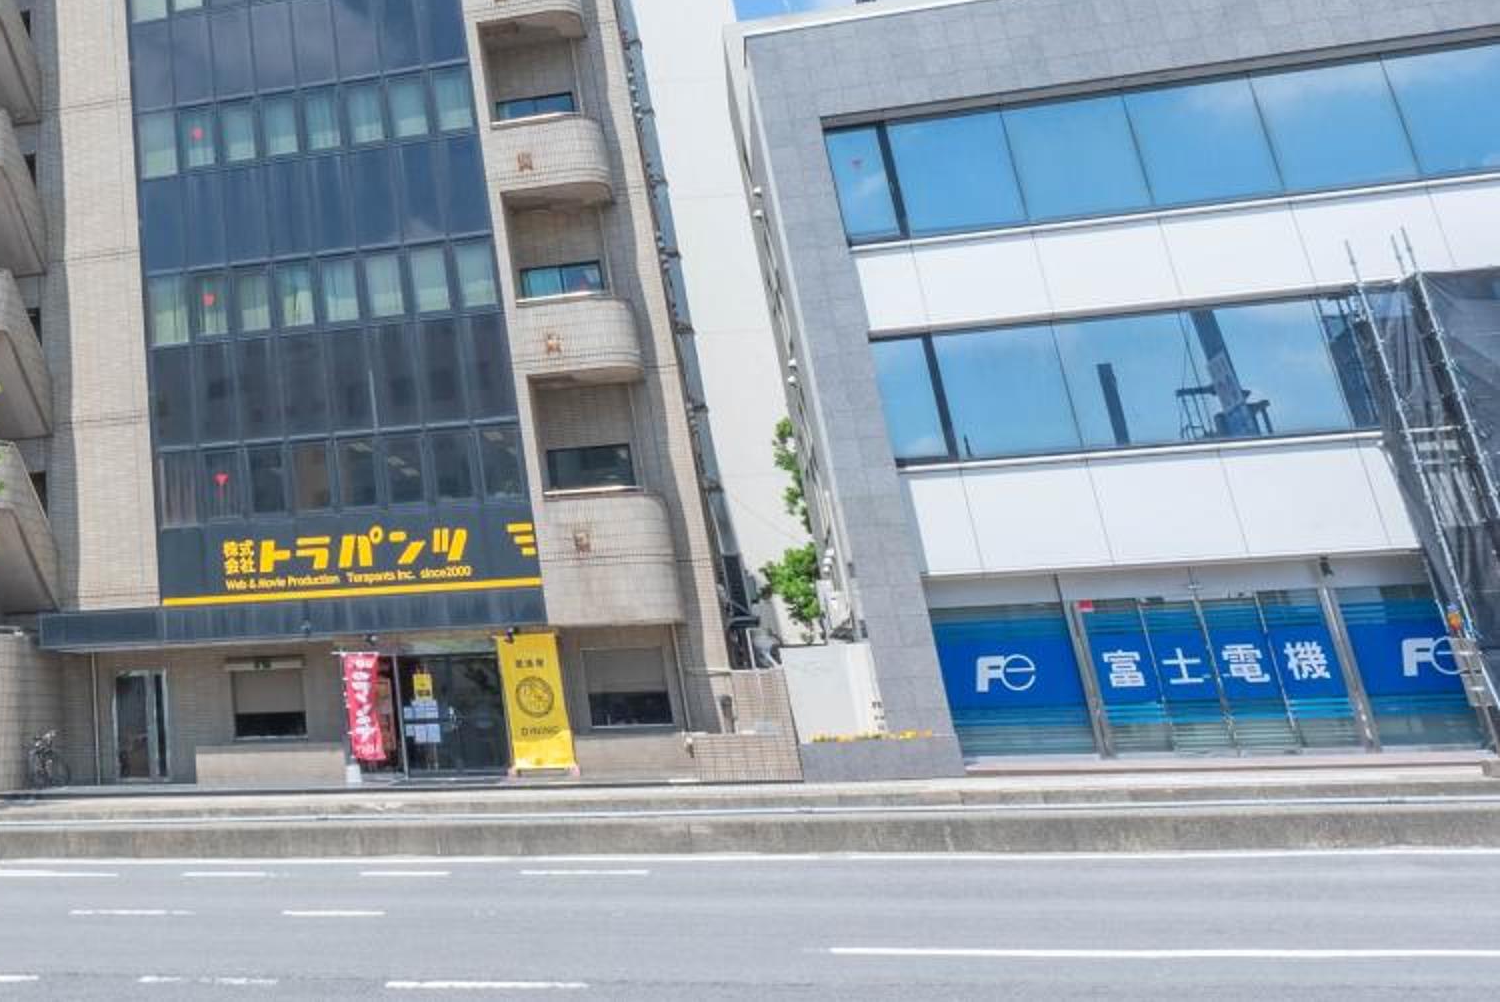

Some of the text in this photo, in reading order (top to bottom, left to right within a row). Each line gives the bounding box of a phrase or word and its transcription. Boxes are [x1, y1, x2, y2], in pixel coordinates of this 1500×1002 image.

[260, 525, 468, 573] トラパンツ
[225, 578, 247, 590] Web
[288, 574, 340, 587] Production
[1102, 641, 1331, 689] 富士電機
